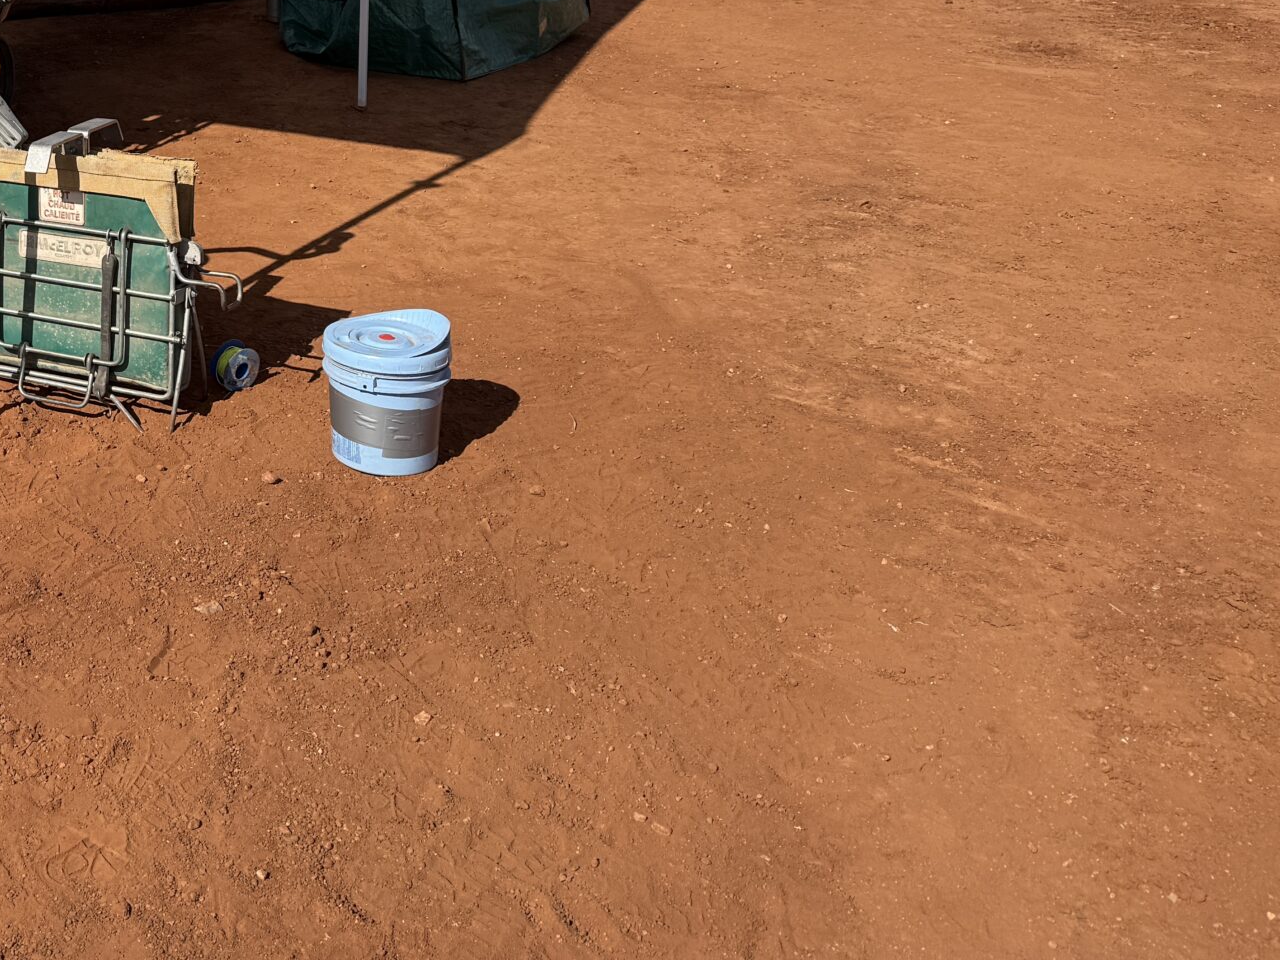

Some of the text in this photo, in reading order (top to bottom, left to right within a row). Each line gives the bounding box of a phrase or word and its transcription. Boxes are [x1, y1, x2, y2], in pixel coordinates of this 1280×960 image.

[53, 189, 70, 200] HOT
[48, 200, 75, 210] CHAUD
[40, 237, 104, 258] McELROY
